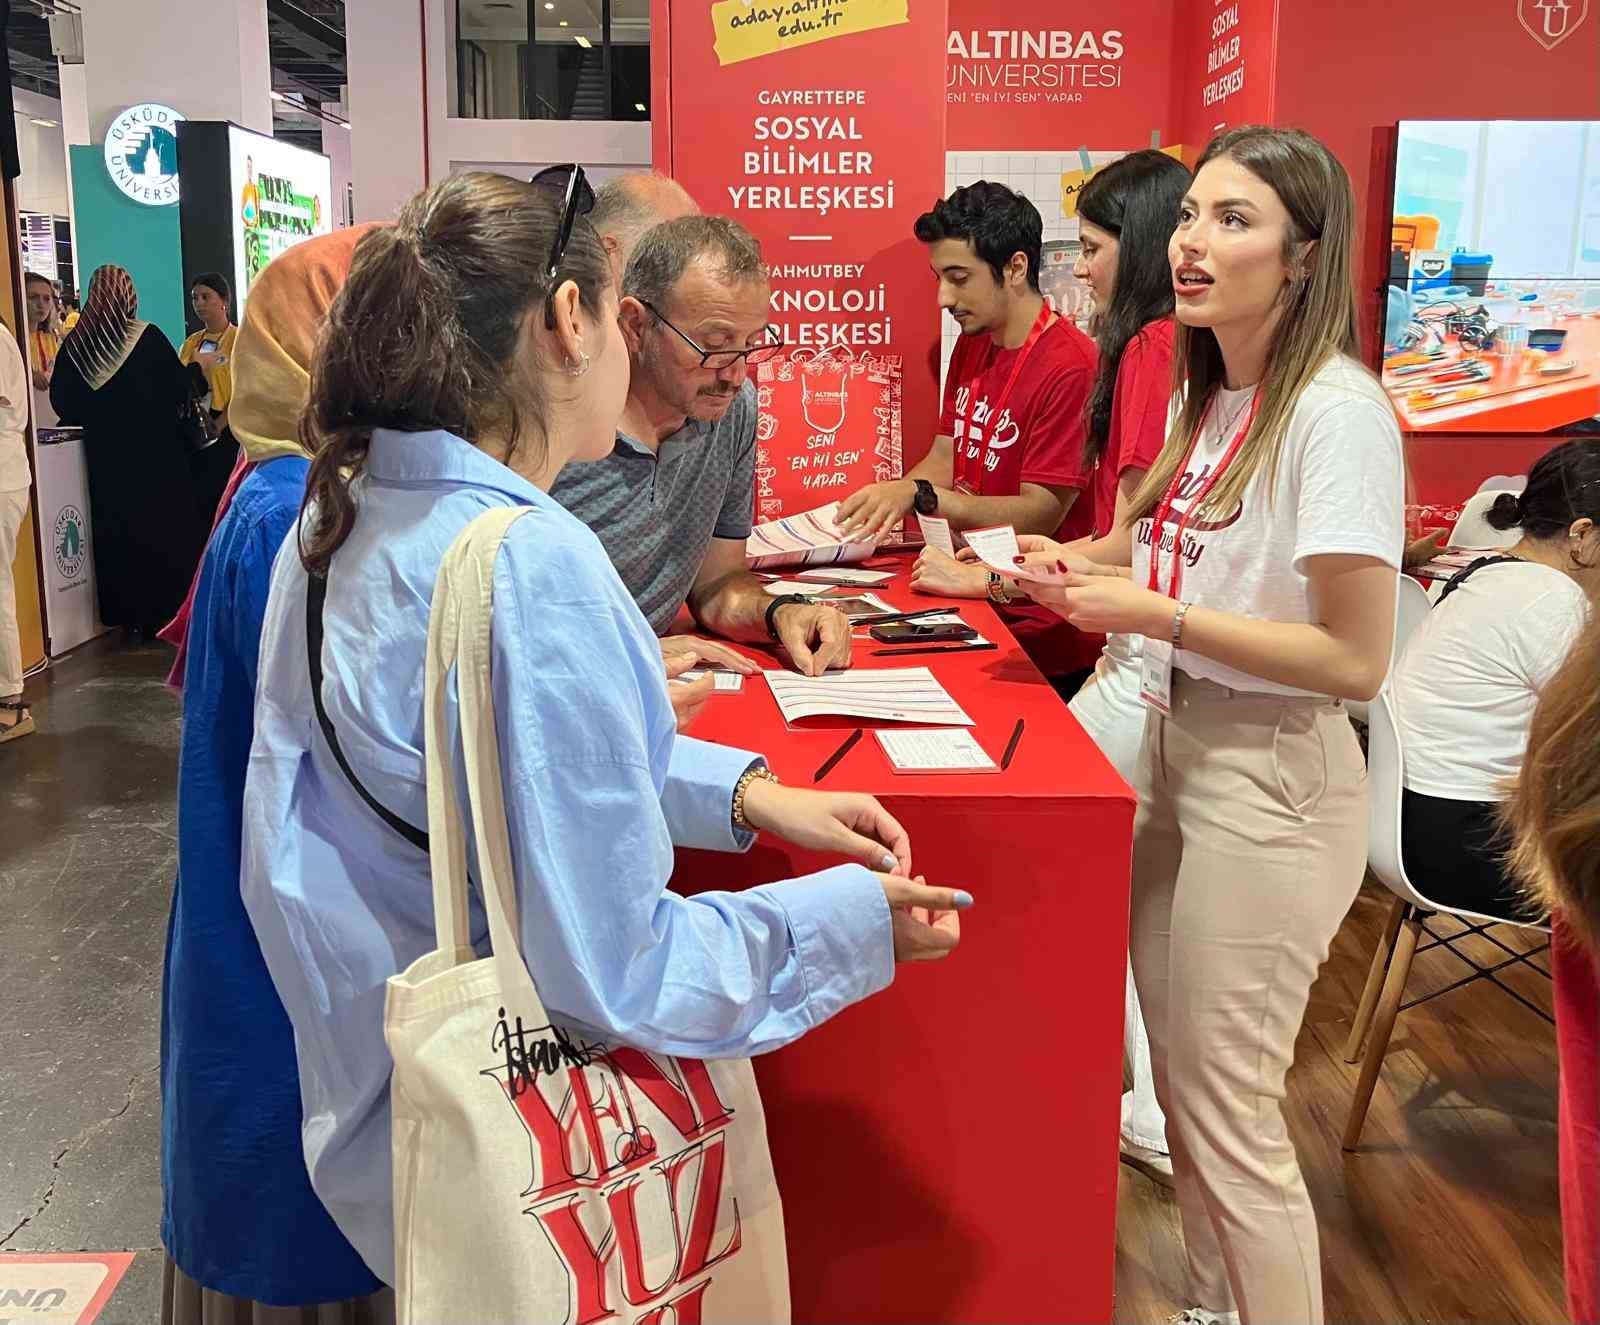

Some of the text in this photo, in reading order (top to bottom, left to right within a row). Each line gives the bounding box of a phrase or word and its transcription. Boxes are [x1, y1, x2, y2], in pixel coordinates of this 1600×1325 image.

[778, 10, 843, 37] edu.tr
[1212, 3, 1239, 40] SOSYAL
[1208, 35, 1240, 74] BİLİMLER
[758, 90, 866, 105] GAYRETTEPE
[1045, 92, 1082, 103] YAPAR
[1203, 59, 1244, 107] YERLEŞKESİ
[754, 117, 863, 141] SOSYAL
[744, 145, 873, 175] BİLİMLER
[728, 179, 894, 215] YERLEŞKESİ
[766, 264, 865, 279] AHMUTBEY
[769, 283, 885, 312] KNOLOJİ
[755, 317, 892, 350] RLEŞKESİ
[803, 473, 848, 489] YAPAR
